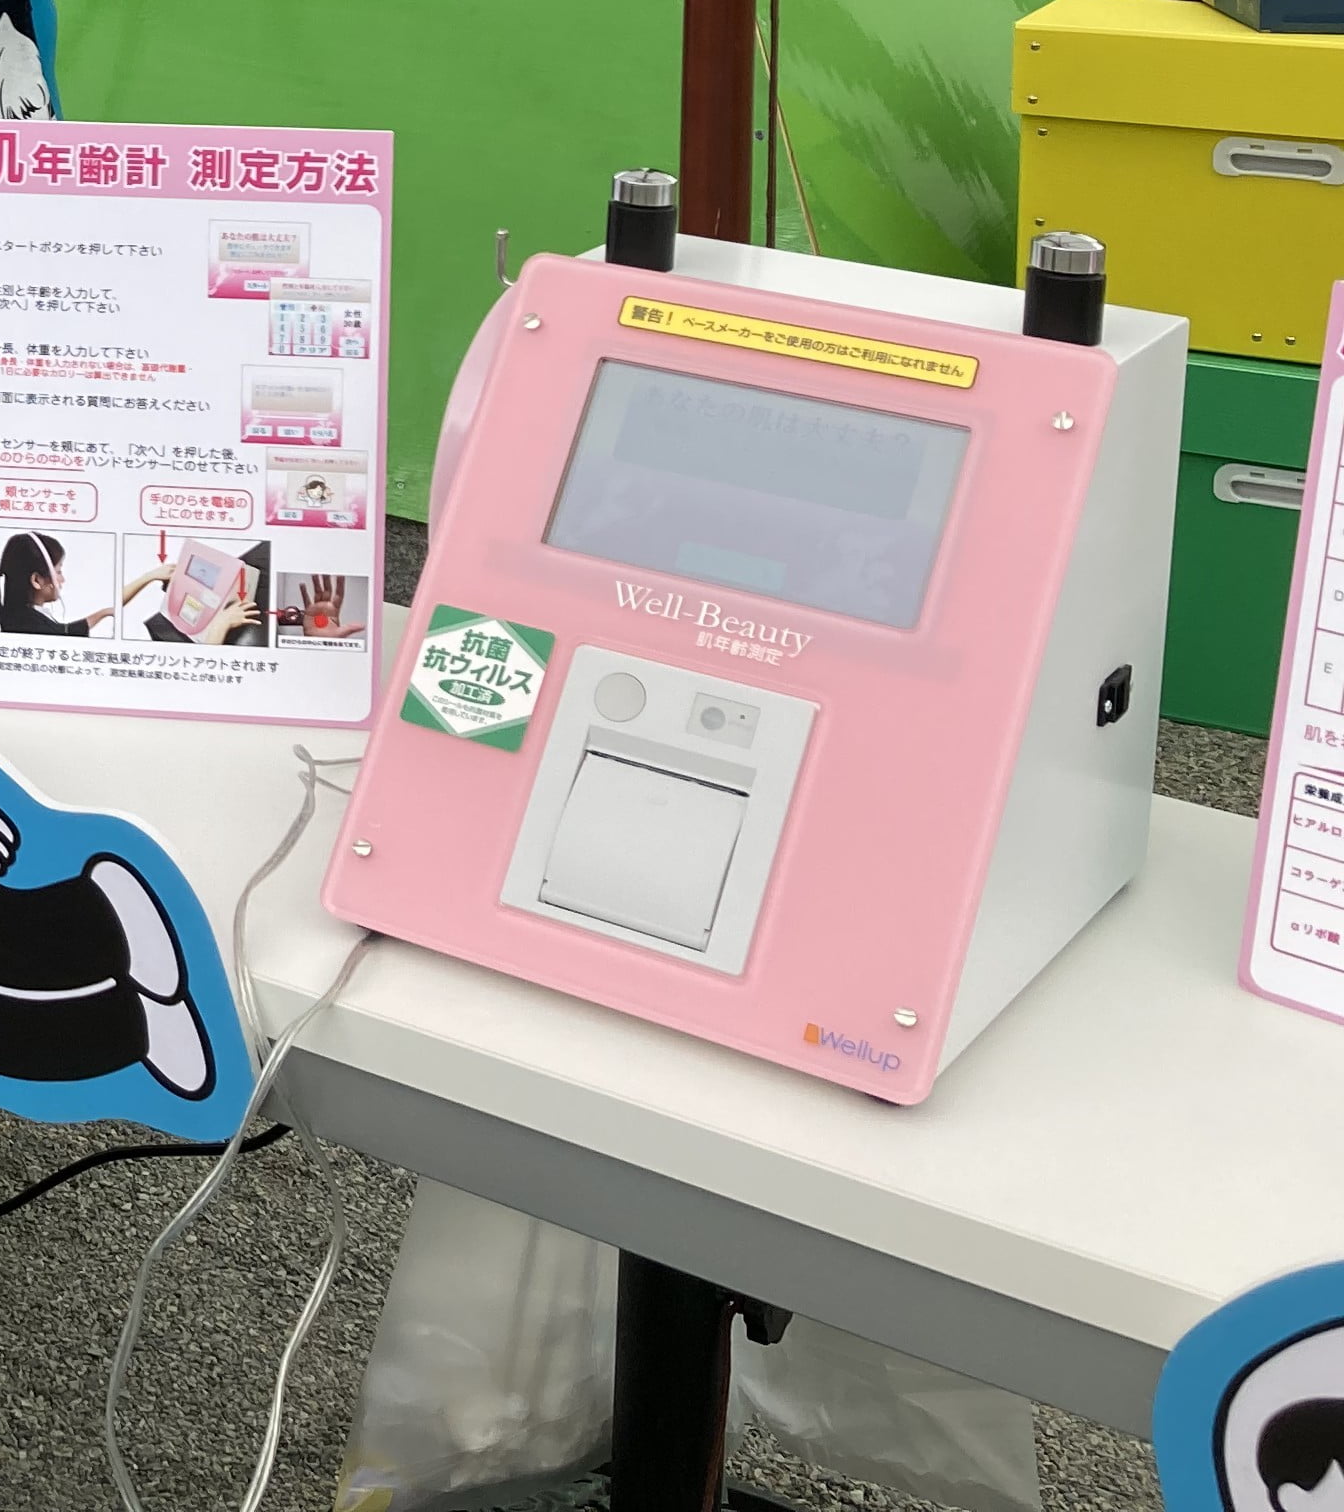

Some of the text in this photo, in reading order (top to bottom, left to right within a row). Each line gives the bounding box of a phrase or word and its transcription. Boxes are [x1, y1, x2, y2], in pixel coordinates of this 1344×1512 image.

[190, 146, 380, 195] 測定方法
[615, 579, 814, 658] Well-Beauty
[423, 644, 534, 695] 抗ウィルス
[460, 629, 514, 663] 抗菌
[820, 1027, 901, 1072] Wellup
